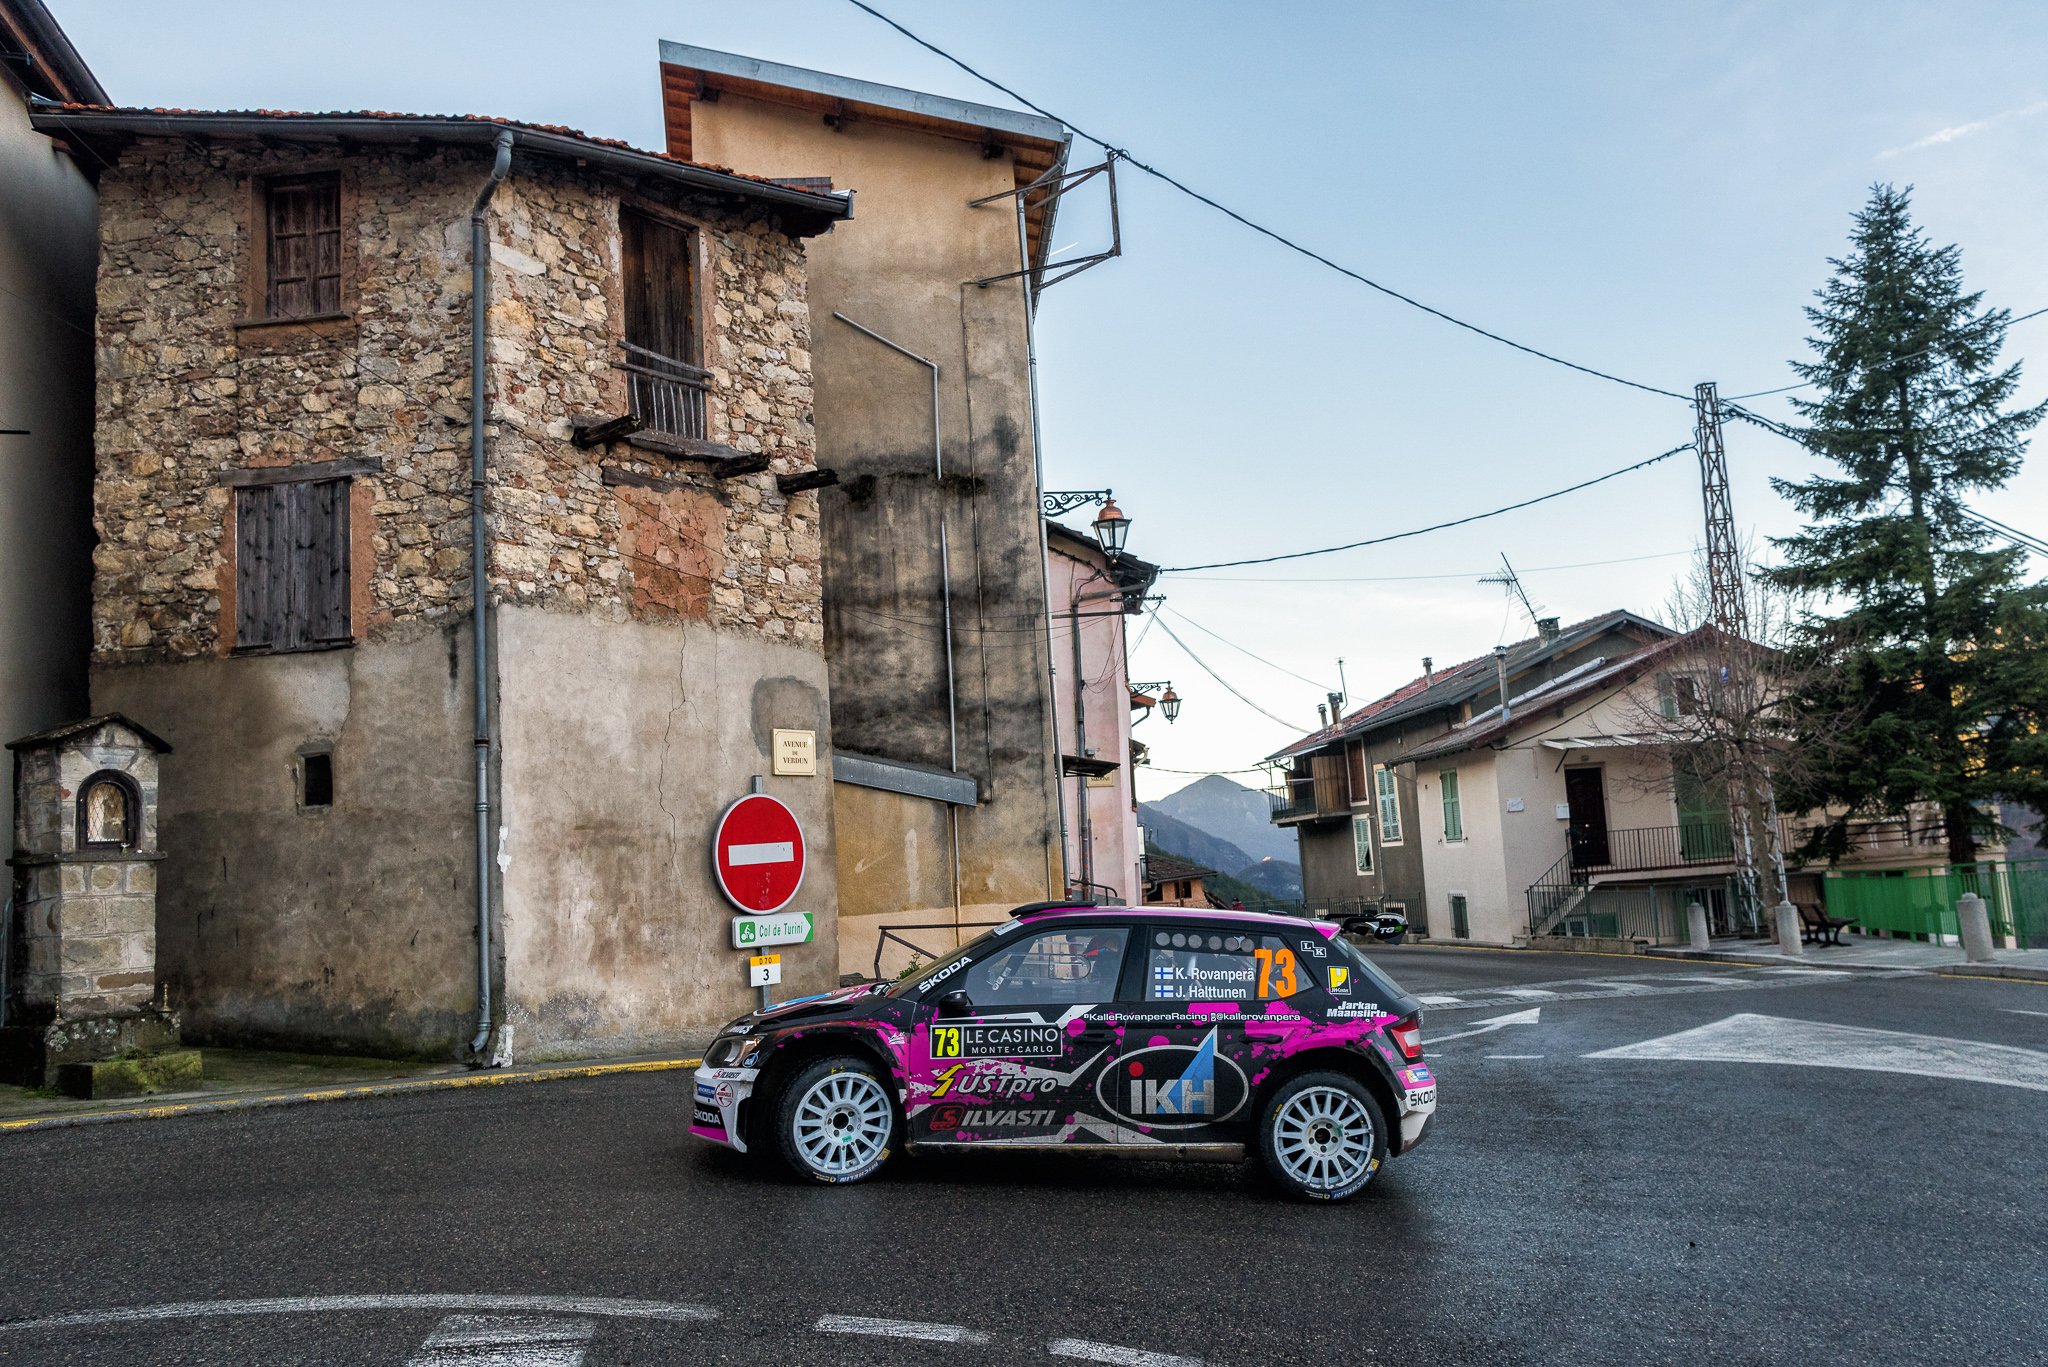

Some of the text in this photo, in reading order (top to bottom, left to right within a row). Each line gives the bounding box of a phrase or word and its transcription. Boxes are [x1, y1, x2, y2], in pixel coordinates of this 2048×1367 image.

[782, 740, 808, 749] AVENUE
[782, 757, 808, 765] VERDUN
[759, 921, 803, 938] Col de Turini
[763, 968, 770, 981] 3
[918, 956, 973, 994] ŠKODA
[1175, 967, 1255, 984] K. Rovanperä
[1254, 947, 1297, 998] 73
[1175, 985, 1247, 998] J. Halttunen
[1338, 1000, 1378, 1010] Jarkan
[1326, 1008, 1388, 1018] Maansiirto
[934, 1027, 960, 1057] 73
[966, 1028, 1058, 1043] LE CASINO
[942, 1108, 1056, 1127] SILVASTI
